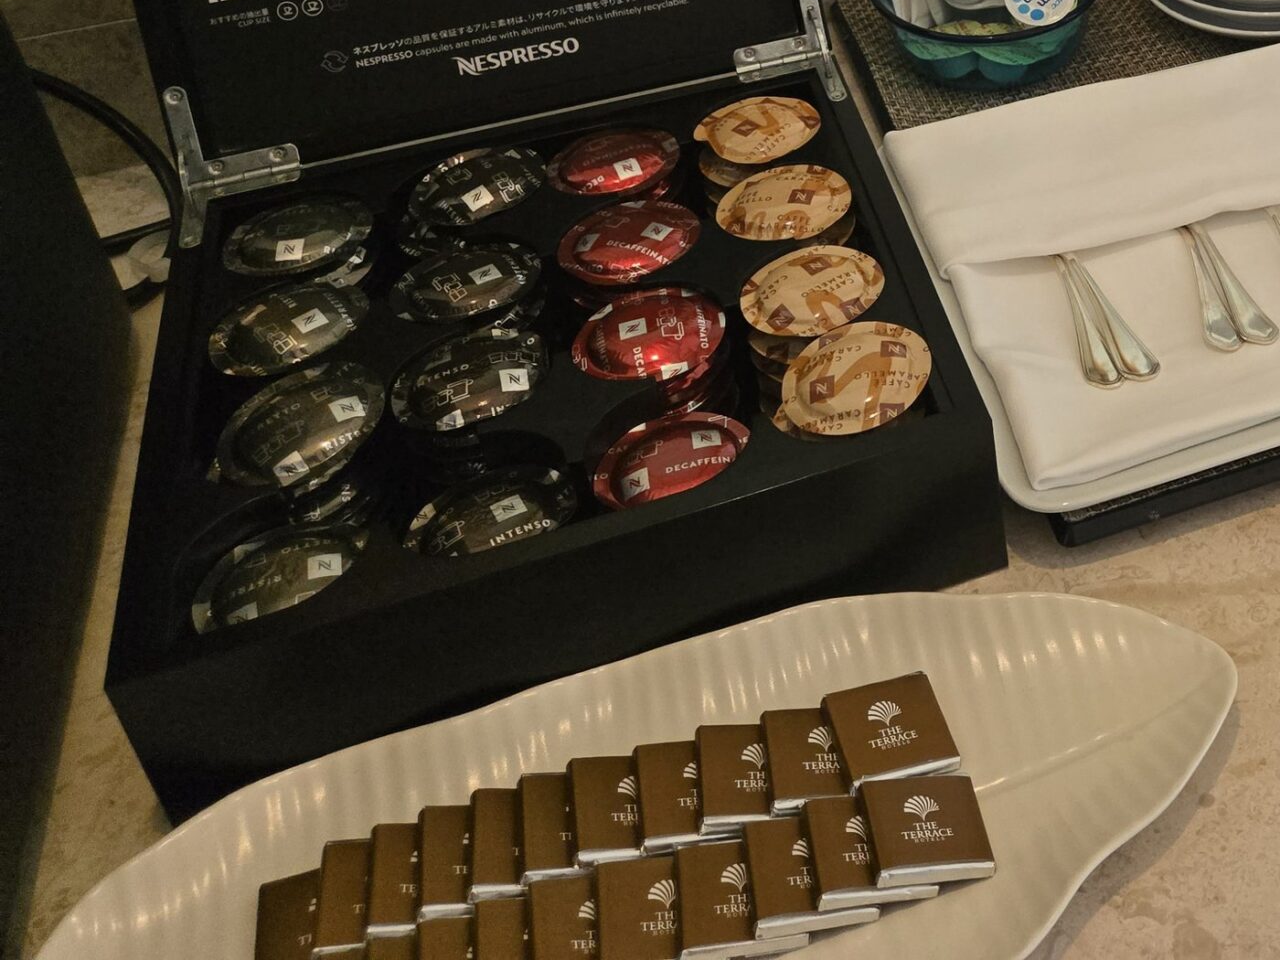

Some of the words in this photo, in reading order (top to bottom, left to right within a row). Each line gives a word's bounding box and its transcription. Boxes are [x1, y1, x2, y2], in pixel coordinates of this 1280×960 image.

[355, 50, 413, 68] NESPRESSO
[415, 44, 454, 56] capsules
[455, 40, 470, 49] are
[471, 34, 497, 45] made
[499, 30, 520, 39] with
[521, 22, 567, 36] aluminum,
[568, 15, 595, 26] which
[604, 6, 642, 19] infinitely
[454, 38, 579, 75] NESPRESSO
[665, 455, 733, 475] DECAFFEIN
[489, 518, 551, 547] INTENSO
[878, 725, 903, 738] THE
[867, 729, 919, 749] TERRACE
[802, 761, 841, 770] TERRA
[748, 771, 766, 780] TH
[913, 821, 939, 830] THE
[901, 827, 954, 840] TERRACE
[728, 893, 748, 904] TH
[655, 911, 676, 921] TH
